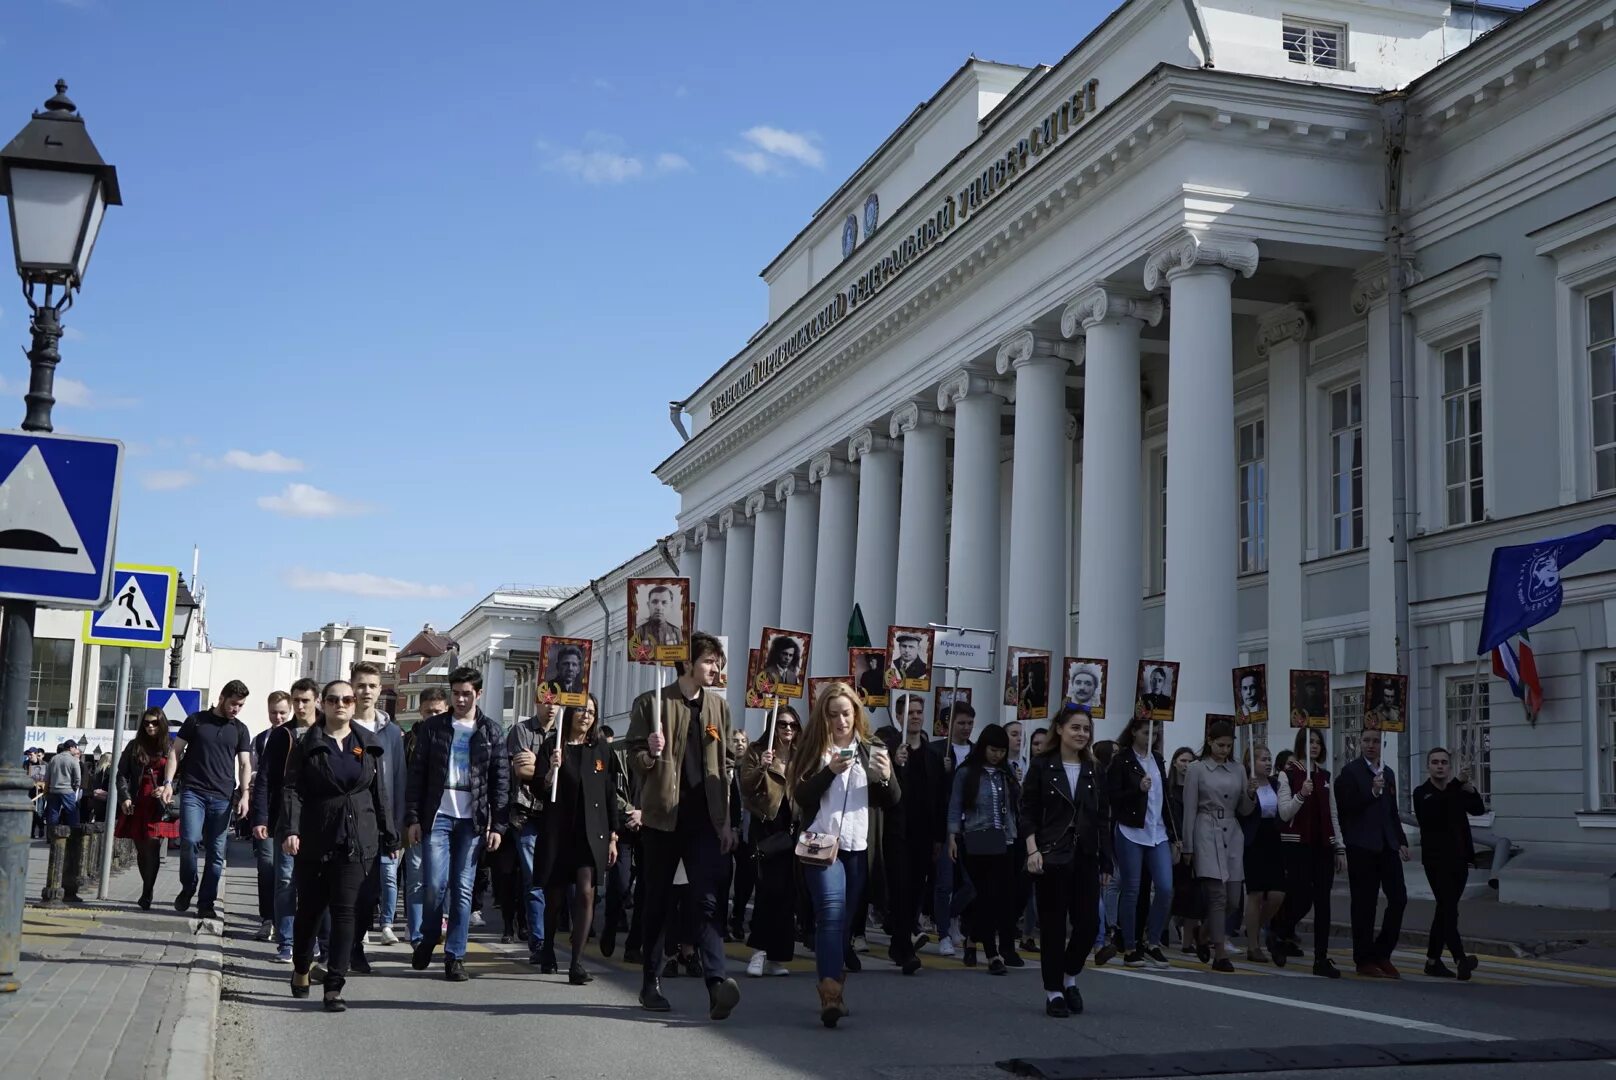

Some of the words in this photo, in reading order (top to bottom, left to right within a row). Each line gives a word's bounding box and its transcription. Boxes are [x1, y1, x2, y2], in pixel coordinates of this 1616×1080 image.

[848, 195, 955, 308] ФЕДЕРАЛЬНЫЙ
[958, 78, 1099, 218] УНИВЕРСИТЕТ
[940, 640, 981, 649] Юридический
[945, 649, 974, 657] факультет
[25, 731, 46, 742] НИ
